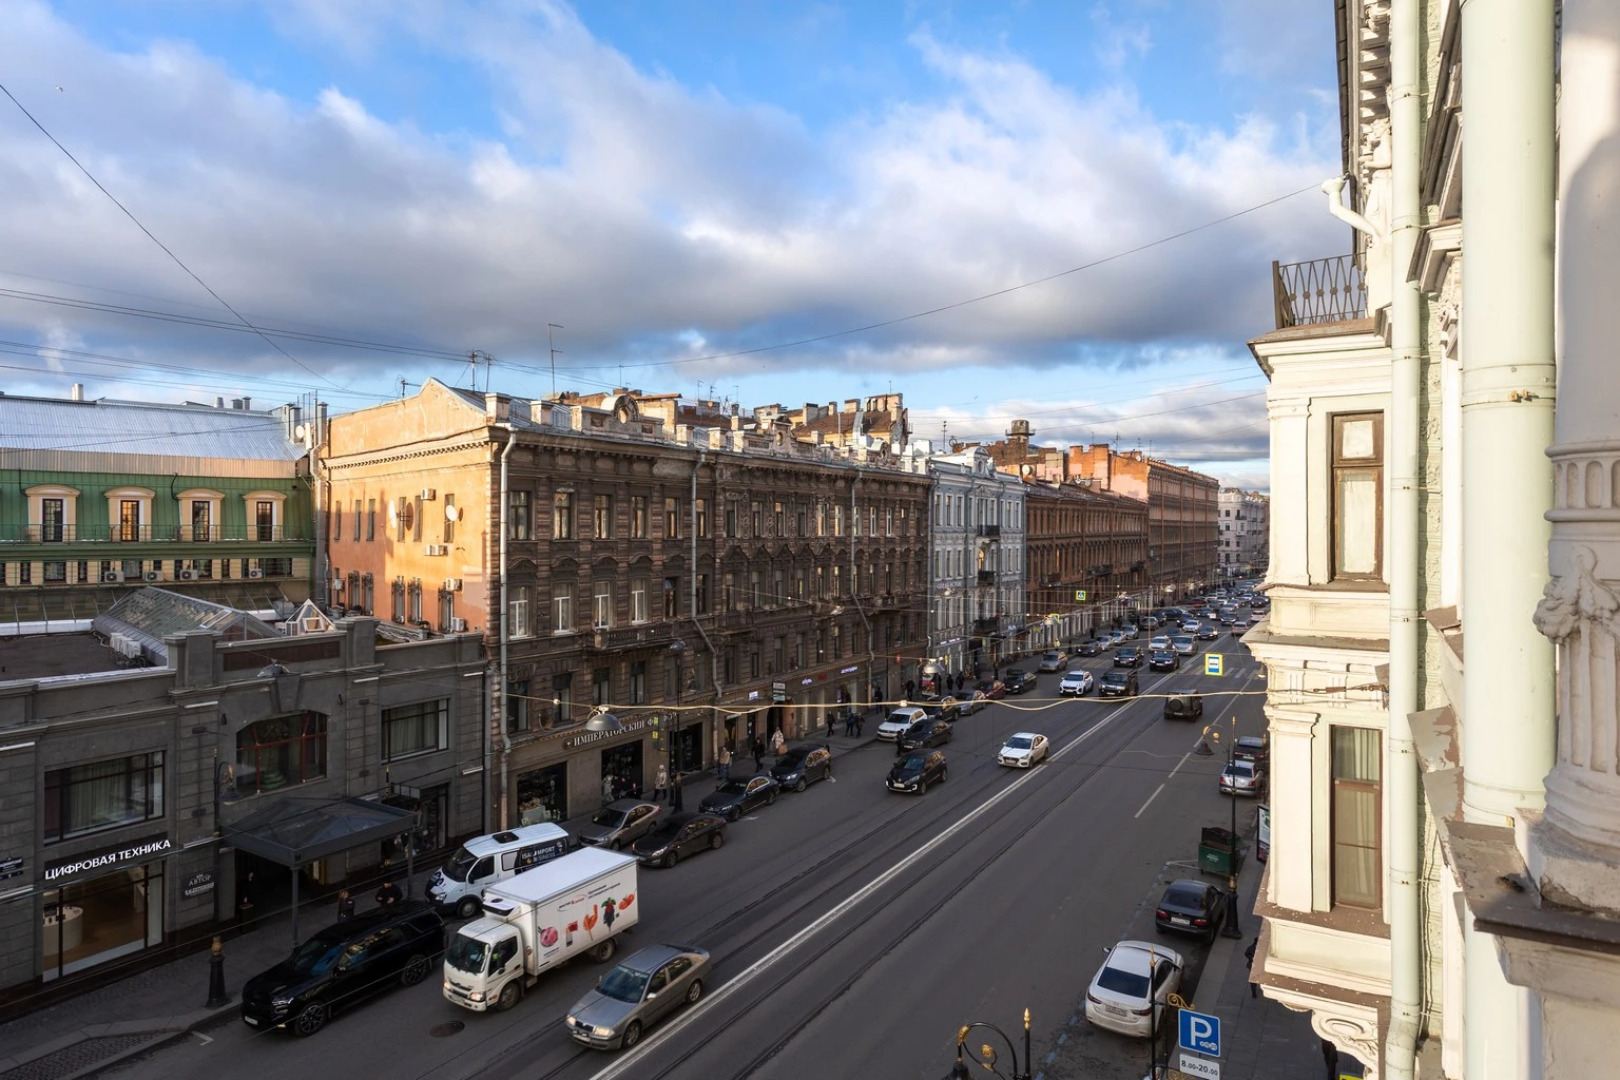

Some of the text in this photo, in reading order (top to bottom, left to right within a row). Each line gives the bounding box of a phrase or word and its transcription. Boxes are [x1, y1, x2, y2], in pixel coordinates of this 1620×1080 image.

[44, 839, 171, 881] ЦИФРОВАЯ ТЕХНИКА
[1190, 1016, 1212, 1047] P
[1181, 1059, 1218, 1076] 8.00-20.00
